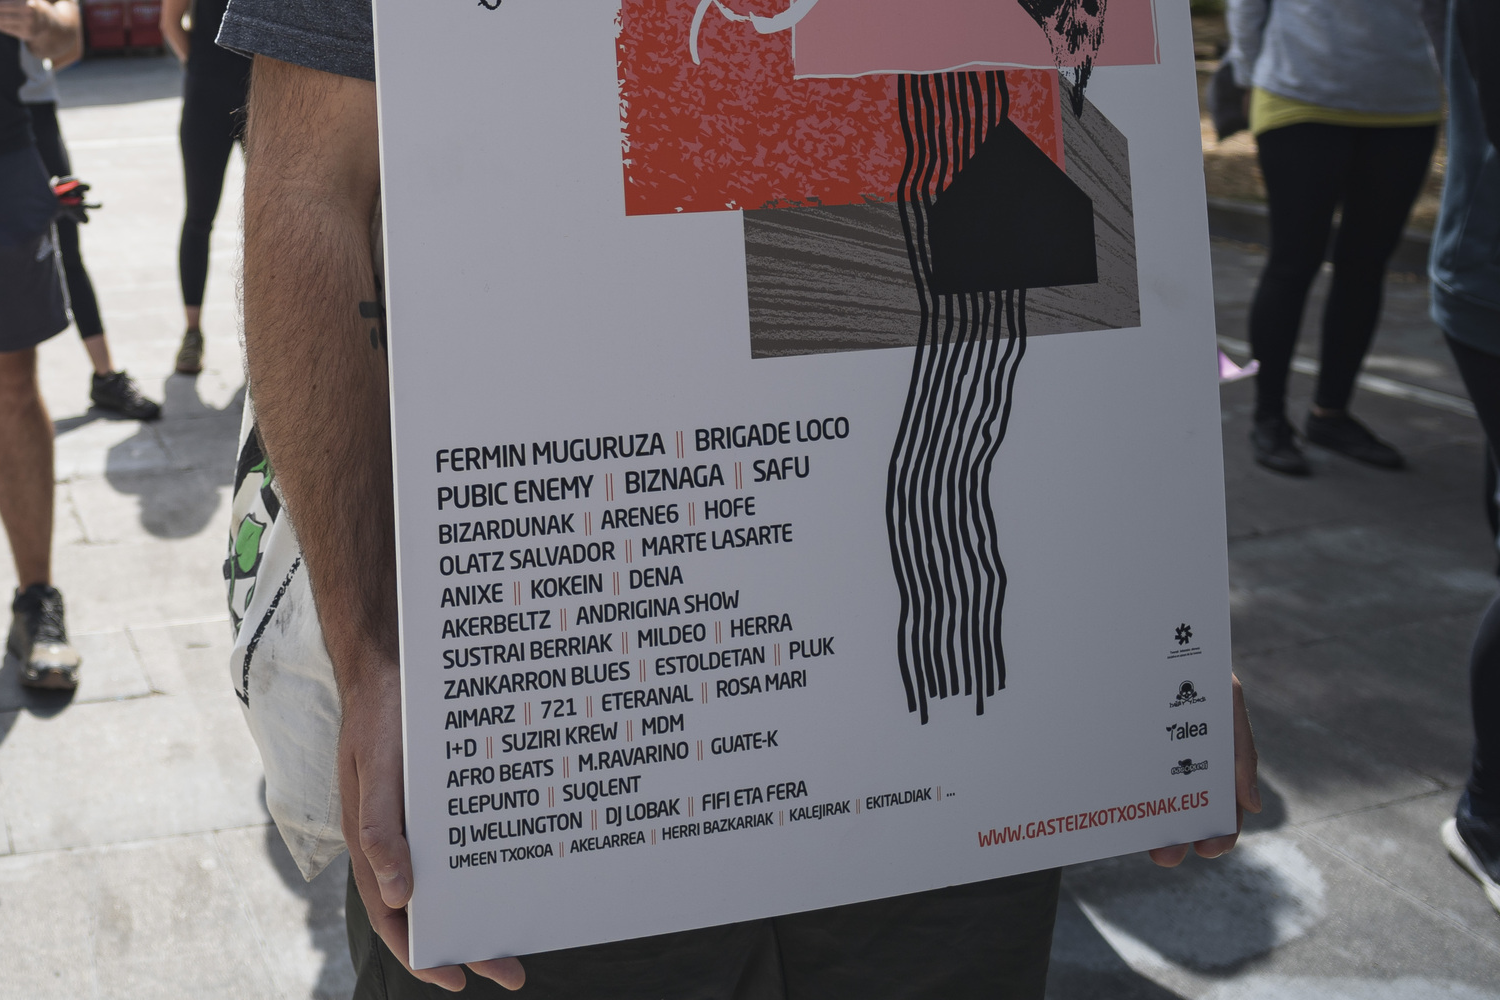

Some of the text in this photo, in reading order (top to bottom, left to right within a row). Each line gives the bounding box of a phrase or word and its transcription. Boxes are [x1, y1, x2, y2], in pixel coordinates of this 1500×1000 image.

[435, 416, 850, 474] FERMIN MUGURUZA BRIGADE LOCO
[437, 455, 810, 511] PUBIC ENEMY BIZNAGA SAFU
[438, 495, 756, 545] BIZARDUNAK ARENE6 HOFE
[439, 522, 794, 577] OLATZ SALVADOR MARTE LASARTE
[440, 564, 684, 609] ANIXE KOKEIN DENA
[441, 589, 740, 640] AKERBELTZ ANDRIGINA SHOW
[442, 612, 794, 670] SUSTRAI BERRIAK MILDEO HERRA
[443, 635, 836, 700] ZANKARRON BLUES ESTOLDETAN PLUK
[444, 669, 807, 731] AIMARZ 721 ETERANAL ROSA MARI
[445, 713, 685, 760] I+D SUZIRI KREW MDM
[446, 765, 496, 789] AFRO
[499, 758, 555, 783] BEATS
[710, 729, 779, 756] GUATE-K
[447, 774, 642, 817] ELEPUNTO SUQLENT
[448, 779, 809, 848] DJ WELLINGTON DJ LOBAK FIFI ETA FERA
[978, 790, 1209, 848] WWW.GASTEIZKOTXOSNAK.EUS
[448, 850, 498, 870] UMEEN
[499, 842, 554, 863] TXOKOA
[569, 830, 646, 854] AKELARREA
[661, 822, 701, 841] HERRI
[702, 811, 774, 835] BAZKARIAK
[789, 799, 851, 823] KALEJIRAK
[865, 786, 933, 810] EKITALDIAK
